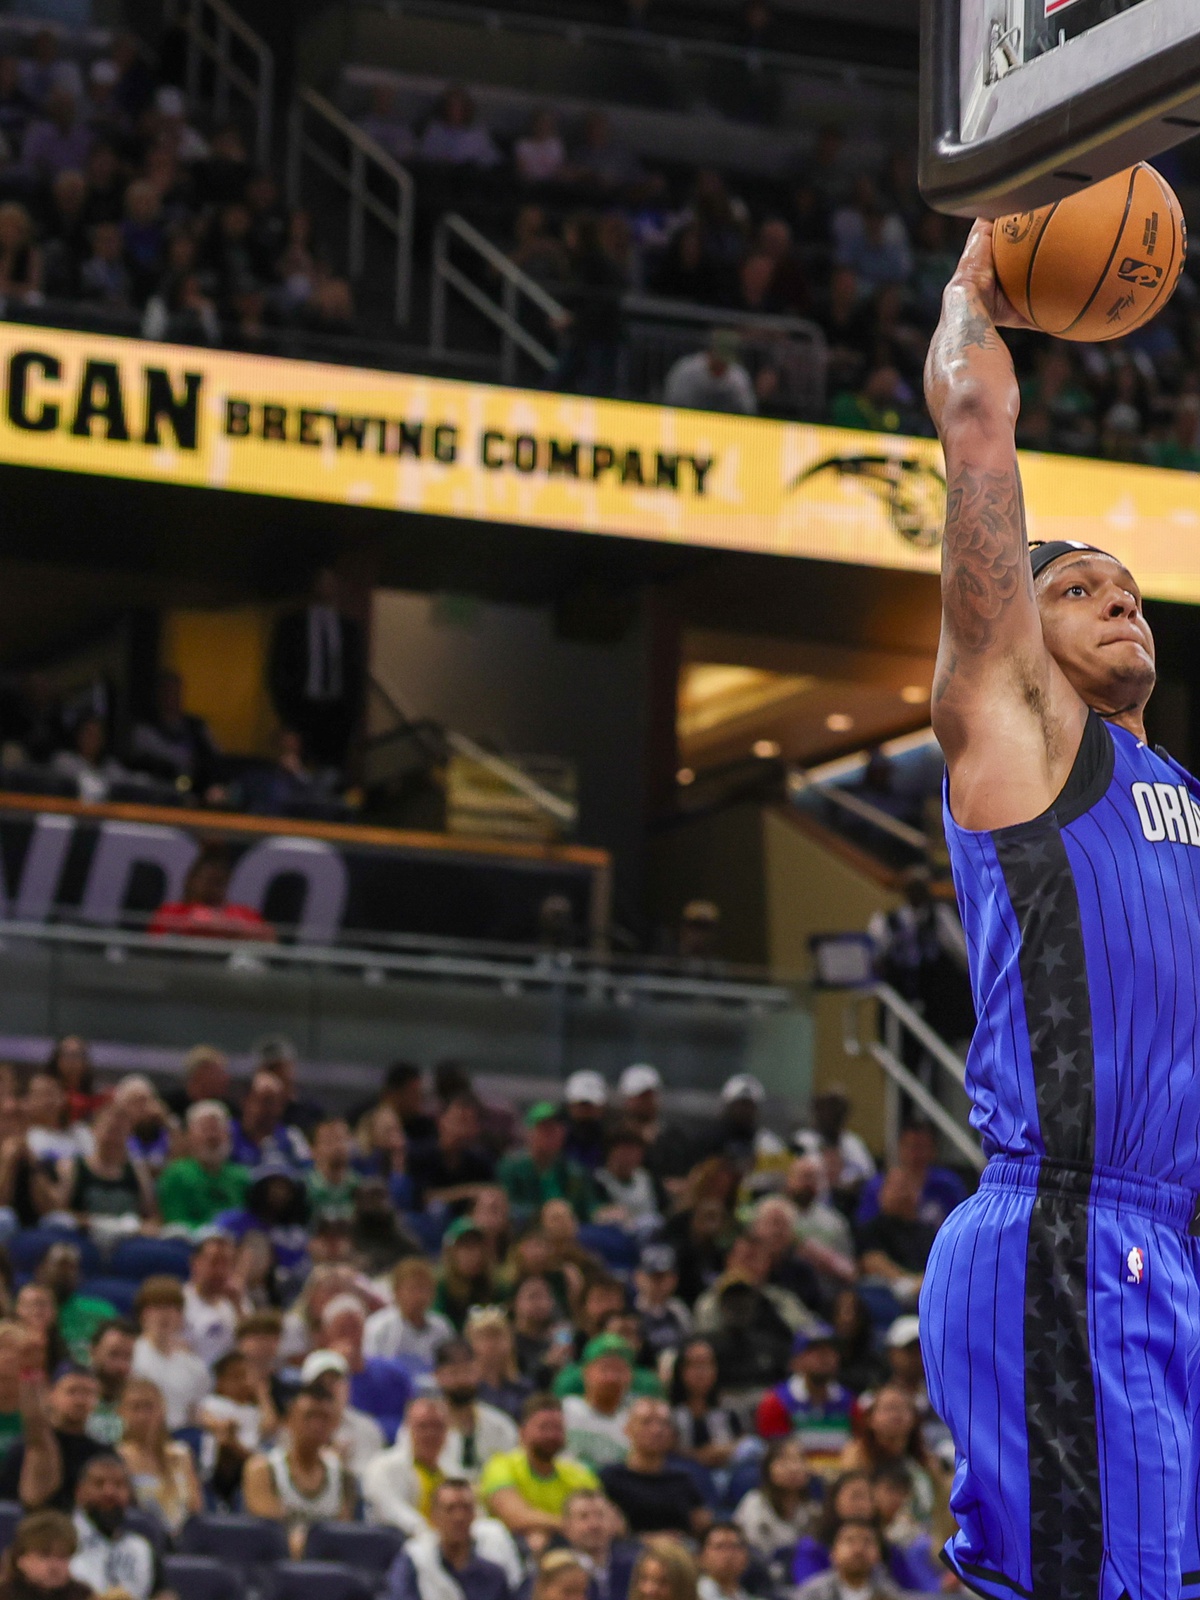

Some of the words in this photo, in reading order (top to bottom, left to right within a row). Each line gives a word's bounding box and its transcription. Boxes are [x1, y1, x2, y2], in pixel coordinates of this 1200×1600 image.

[6, 351, 202, 450] CAN
[226, 400, 456, 463] BREWING
[483, 431, 714, 495] COMPANY
